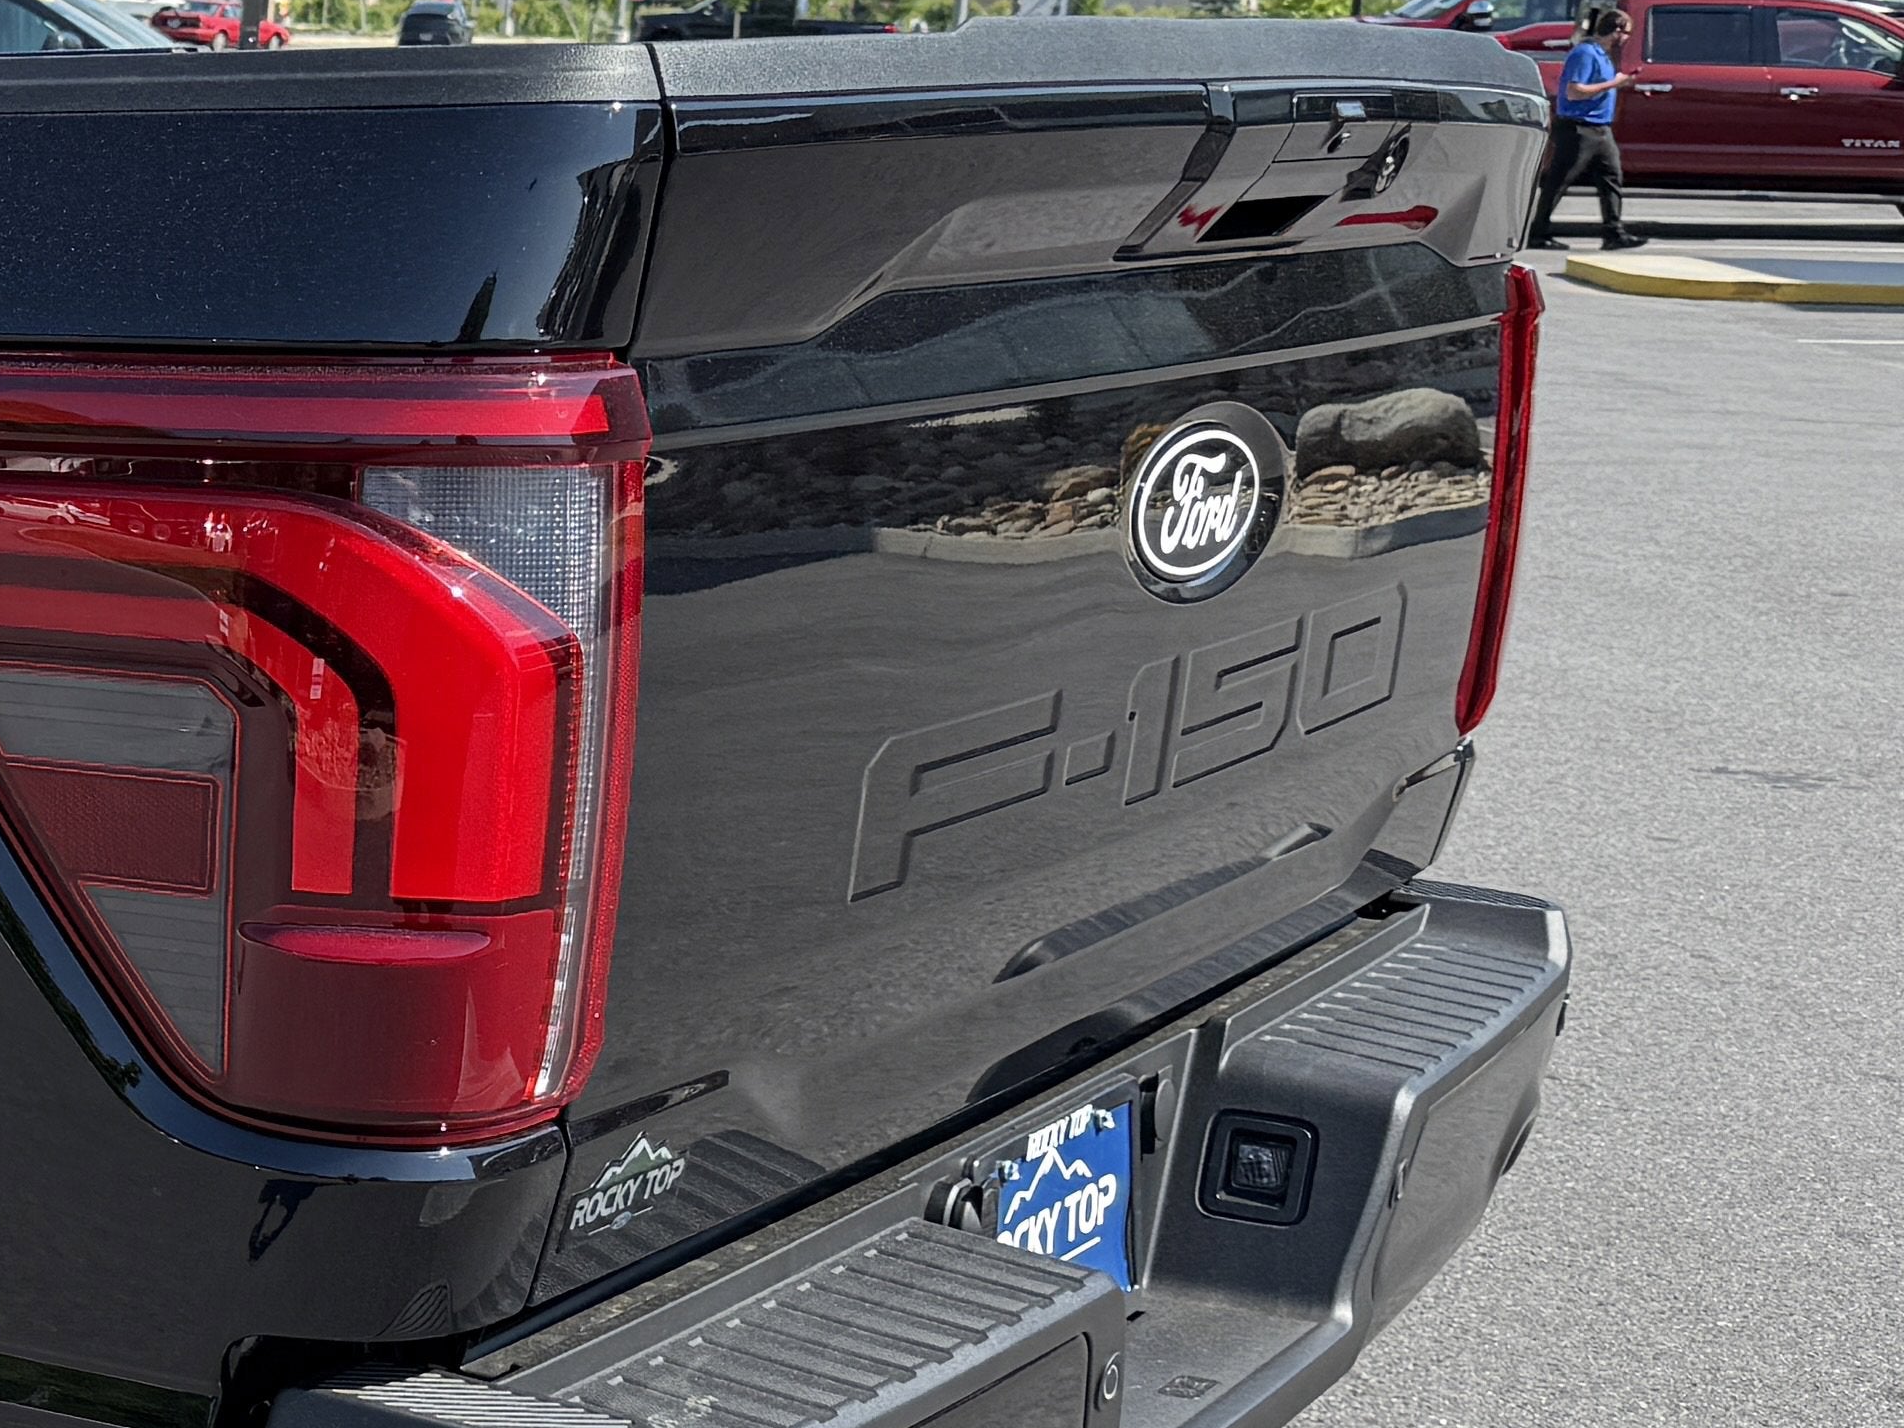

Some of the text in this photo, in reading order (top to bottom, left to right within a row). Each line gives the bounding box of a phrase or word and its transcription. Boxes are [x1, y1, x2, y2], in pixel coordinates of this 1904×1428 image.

[1841, 138, 1901, 148] TITAN
[1160, 451, 1243, 554] Ford
[848, 582, 1405, 903] F-150
[1026, 1104, 1093, 1162] ROCKY TOP
[569, 1173, 644, 1230] ROCKY
[643, 1157, 686, 1200] TOP
[1064, 1173, 1117, 1243] TOP
